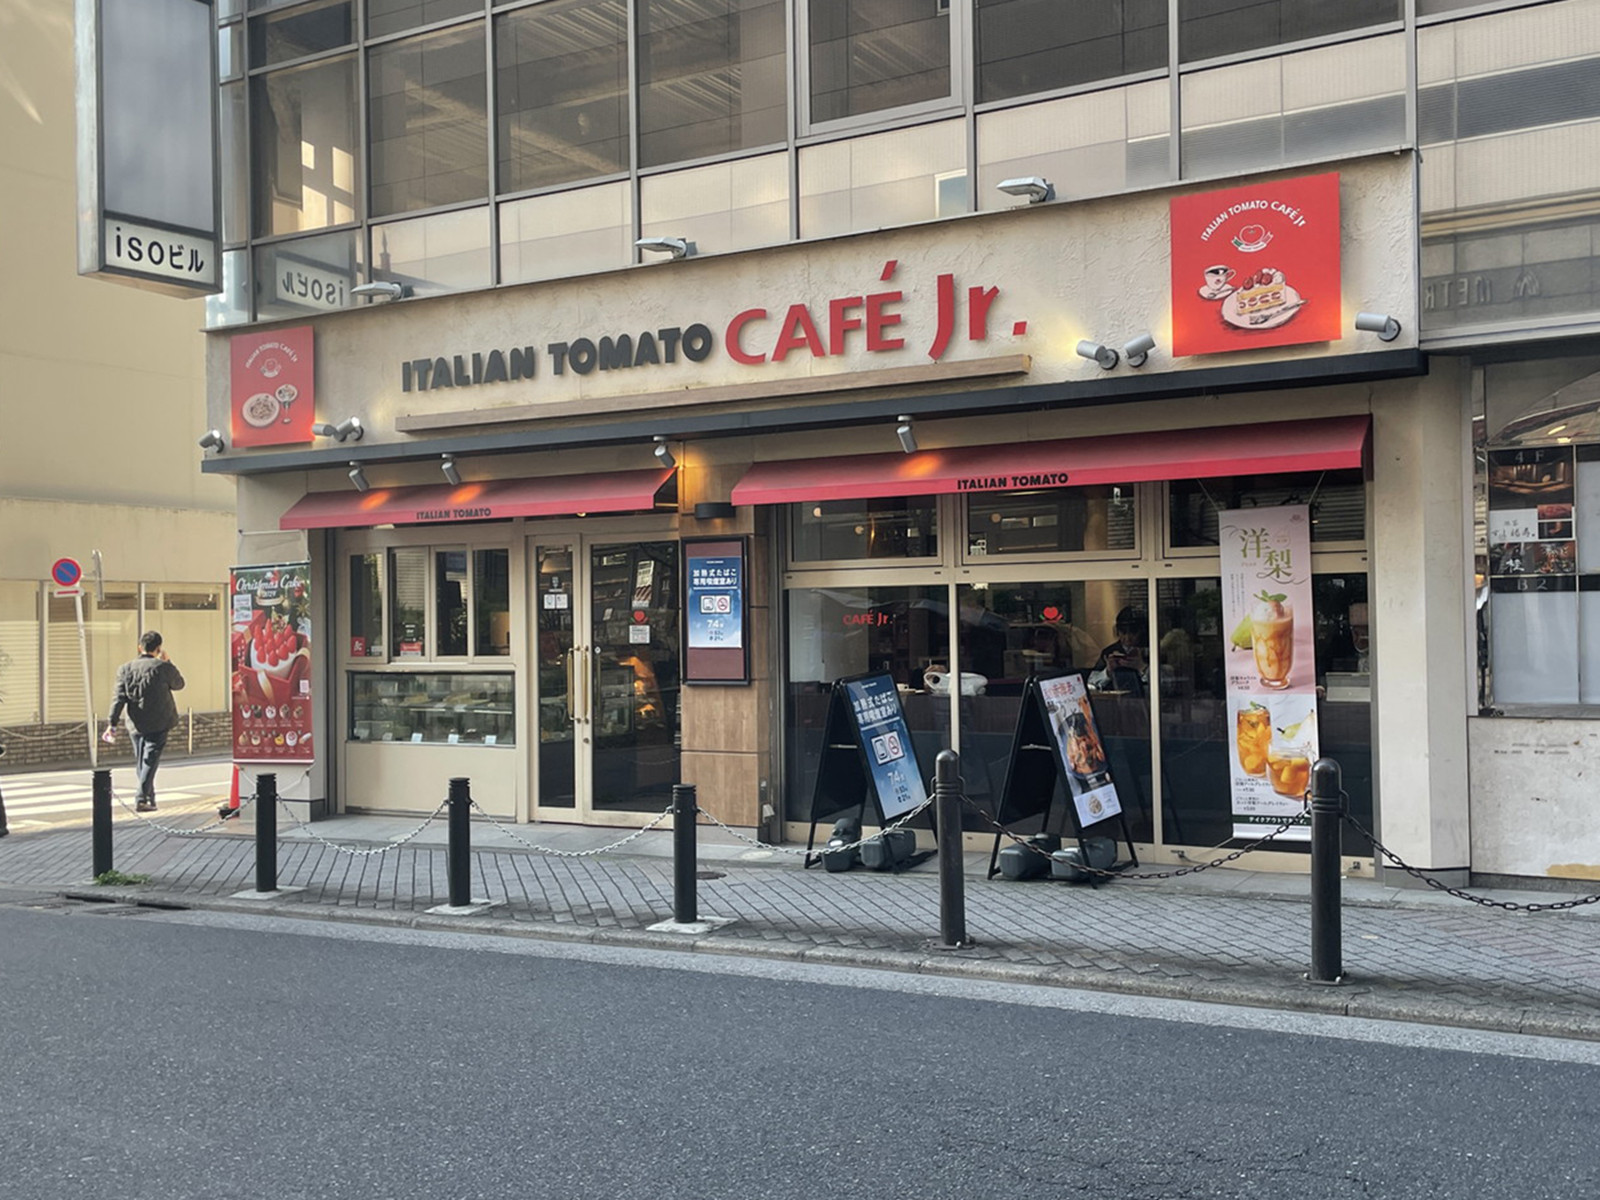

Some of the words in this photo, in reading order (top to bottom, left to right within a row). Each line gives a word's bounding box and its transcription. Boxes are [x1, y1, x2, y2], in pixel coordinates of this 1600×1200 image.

[1200, 211, 1228, 241] ITALIAN
[1228, 200, 1268, 216] TOMATO
[1270, 201, 1300, 220] CAFÉ
[402, 345, 535, 393] ITALIAN
[548, 322, 713, 376] TOMATO
[724, 259, 905, 366] CAFÉ
[928, 273, 1028, 361] Jr.
[957, 477, 1007, 490] ITALIAN
[1011, 473, 1068, 487] TOMATO
[416, 510, 450, 520] ITALIAN
[452, 507, 492, 518] TOMATO
[842, 608, 875, 625] CAFÉ
